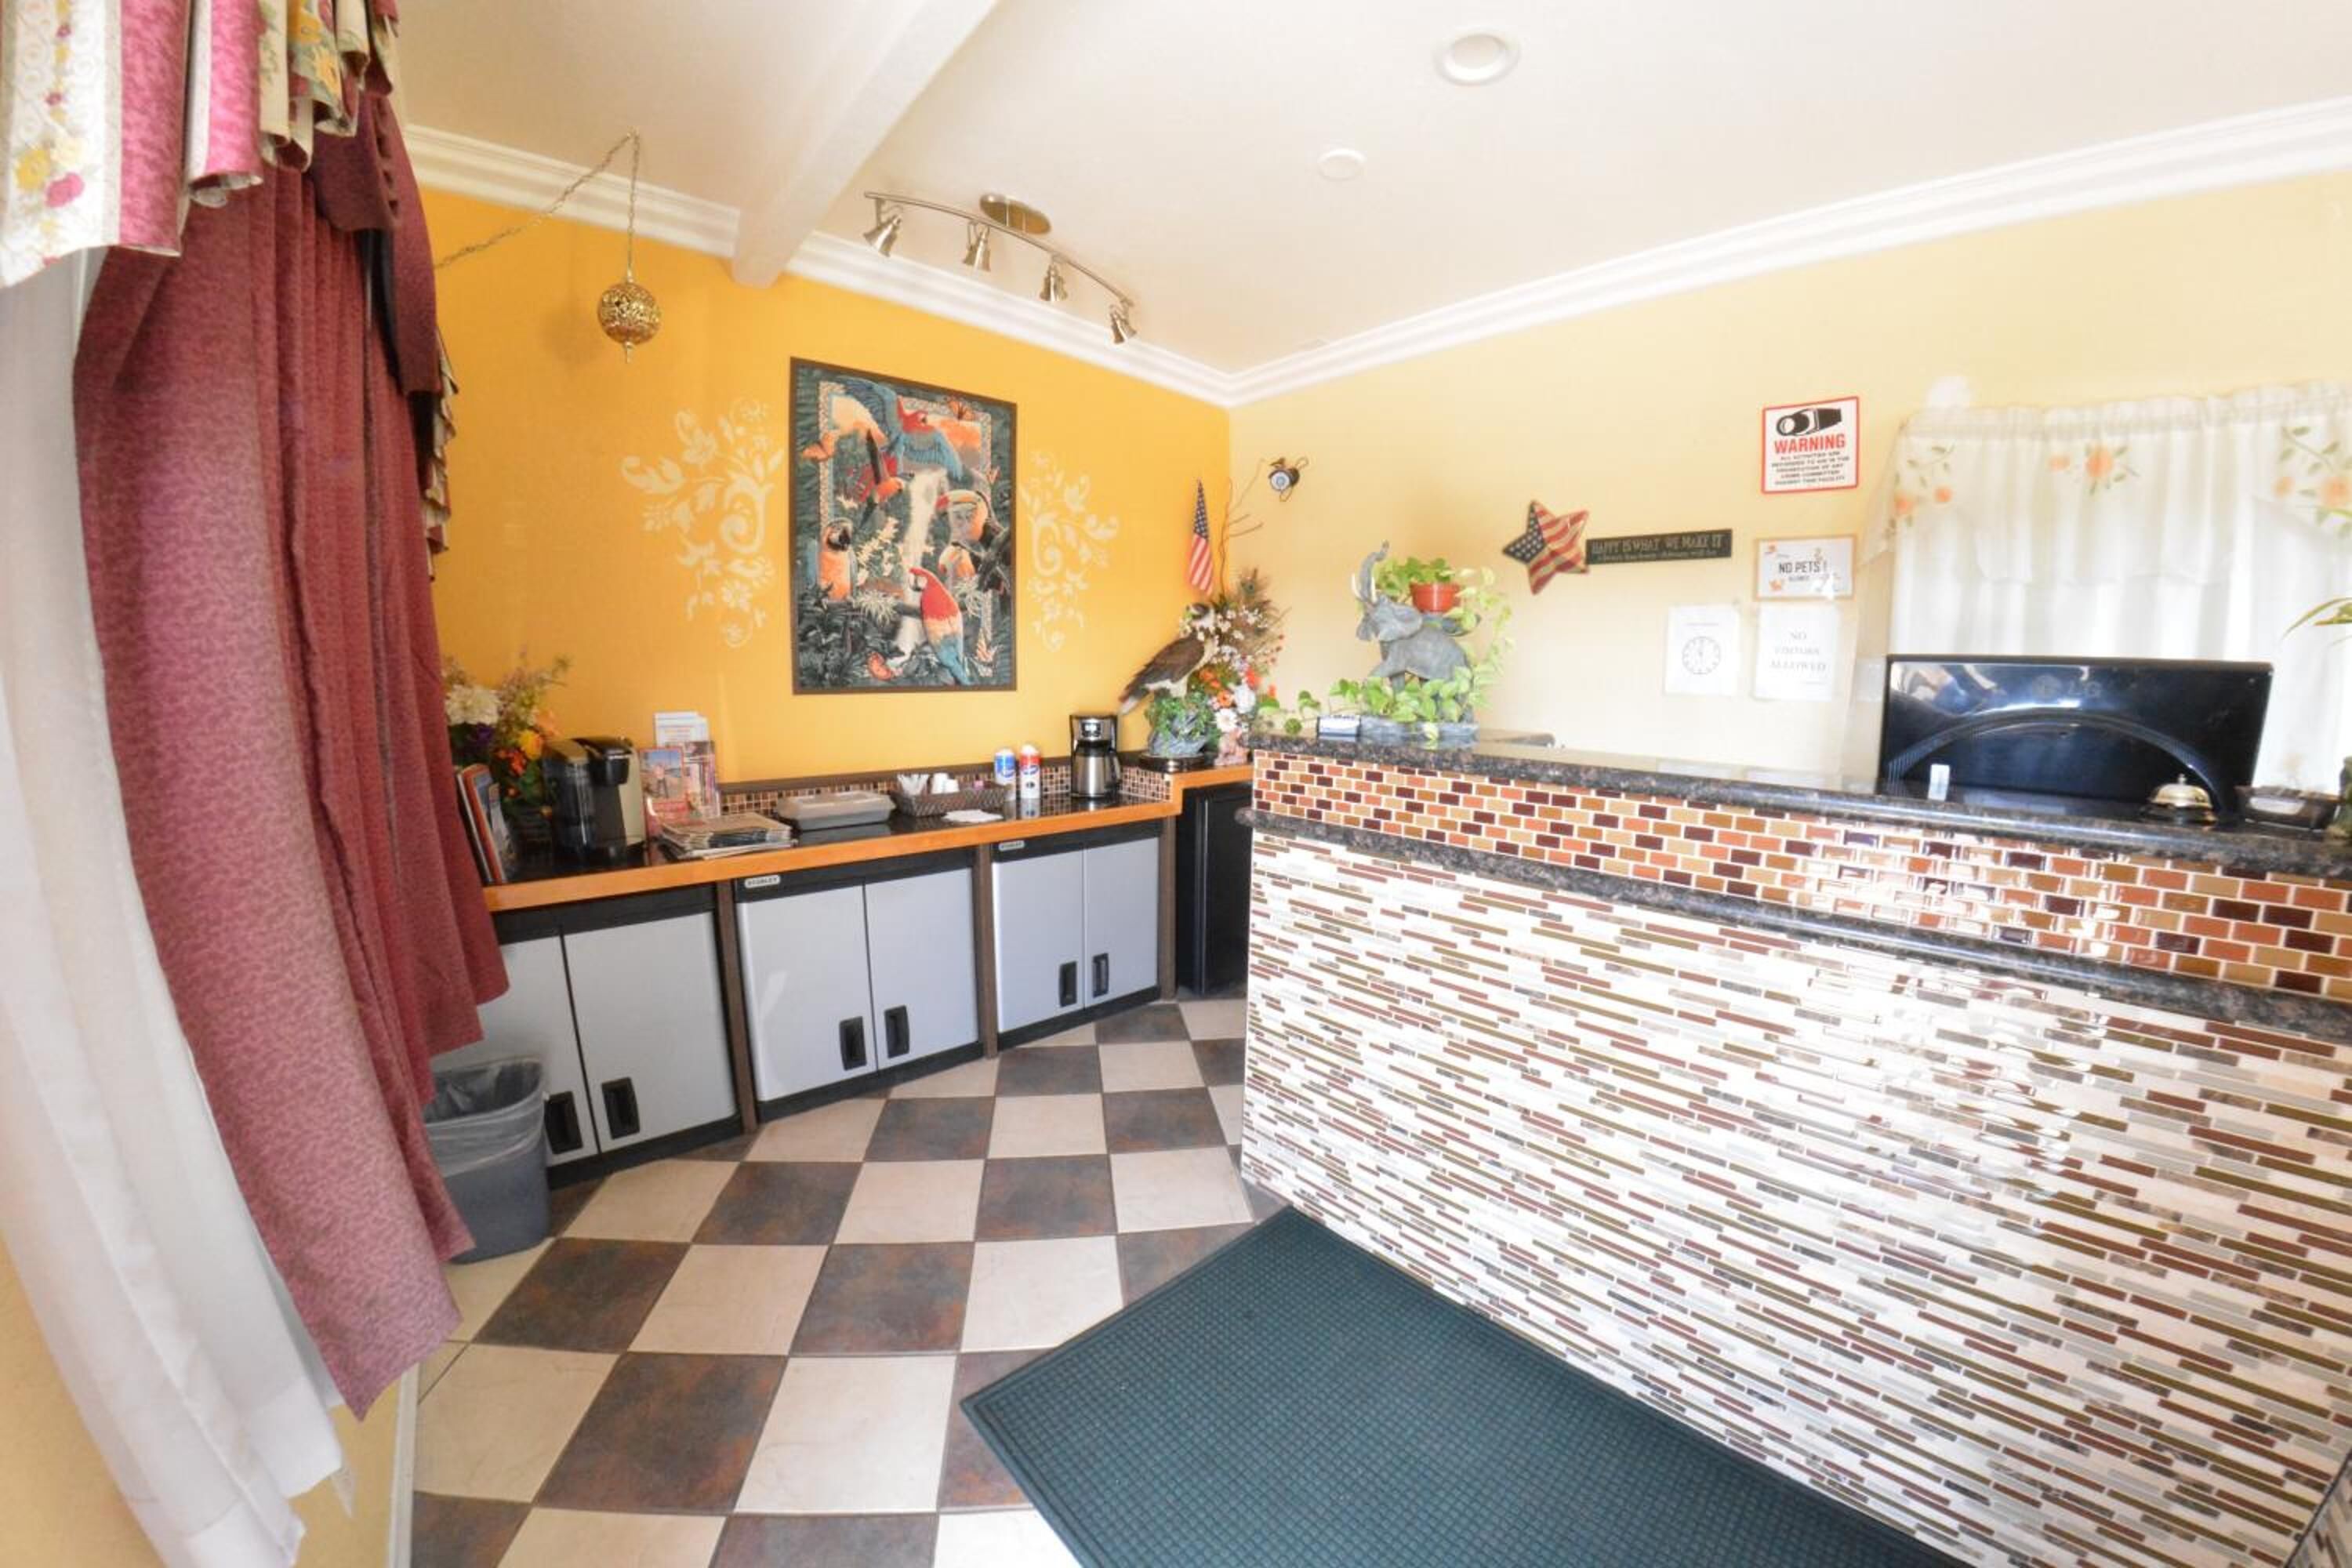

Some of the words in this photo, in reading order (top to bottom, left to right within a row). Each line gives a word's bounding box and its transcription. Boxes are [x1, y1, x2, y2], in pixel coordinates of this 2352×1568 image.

[1774, 434, 1845, 454] WARNING
[1592, 539, 1619, 554] HAPPY
[1632, 538, 1659, 552] WHAT
[1665, 537, 1679, 549] WE
[1681, 535, 1708, 548] MAKE
[1711, 534, 1723, 548] IT
[1779, 561, 1793, 574] NO
[1795, 560, 1820, 573] PETS
[1790, 630, 1807, 641] NO
